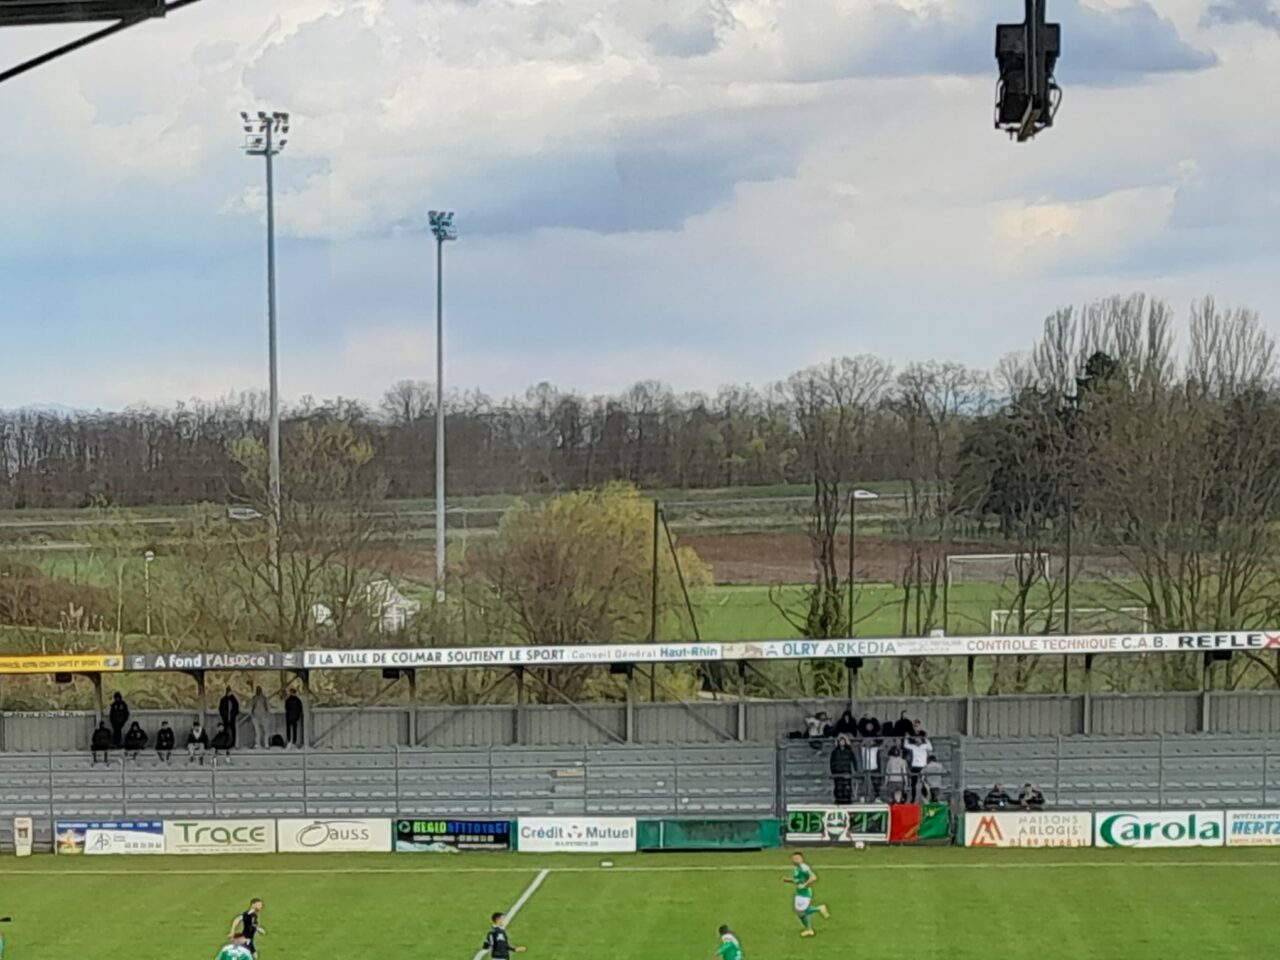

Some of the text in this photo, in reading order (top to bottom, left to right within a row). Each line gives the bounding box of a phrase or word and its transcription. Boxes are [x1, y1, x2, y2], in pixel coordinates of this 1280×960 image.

[660, 645, 718, 658] Haut-Rhin
[782, 643, 819, 656] OLRY
[823, 641, 896, 655] ARKEDIA
[967, 639, 1038, 651] CONTROLE
[1041, 637, 1117, 650] TECHNIQUE
[154, 654, 166, 668] A
[169, 653, 202, 667] fond
[319, 648, 565, 664] LA VILLE DE COLMAR SOUTIENT LE SPORT
[1018, 816, 1079, 825] MAISONS
[173, 822, 266, 846] Trace
[520, 825, 634, 838] Crédit Mutuel
[1100, 813, 1220, 847] Carola
